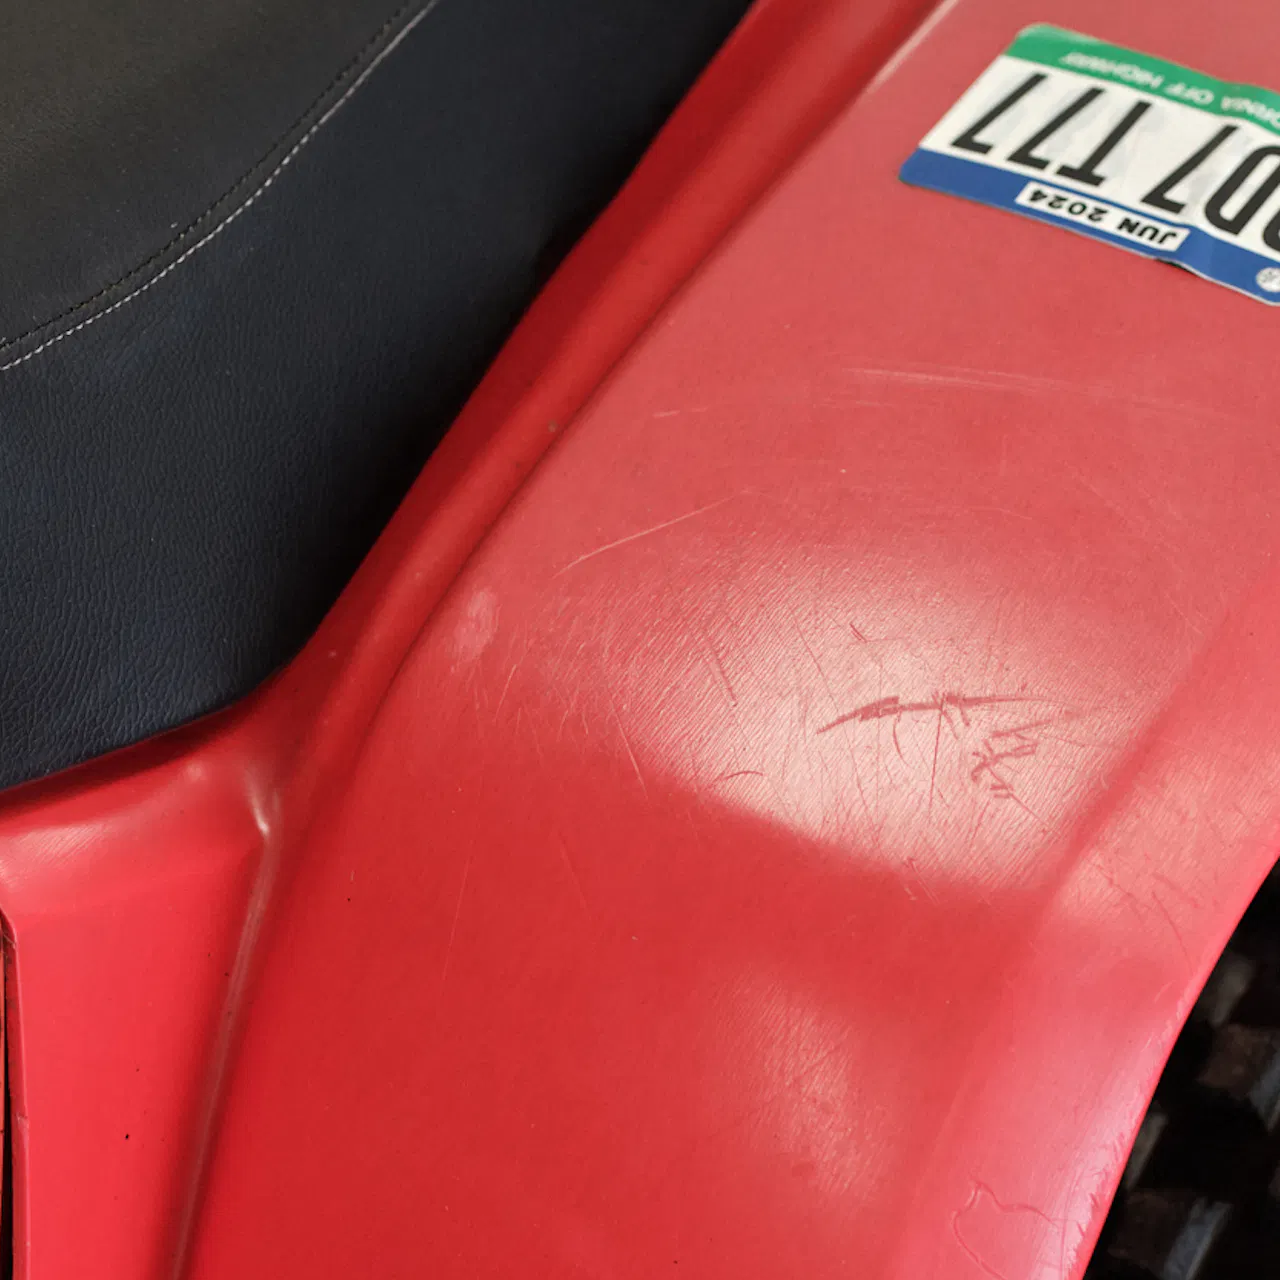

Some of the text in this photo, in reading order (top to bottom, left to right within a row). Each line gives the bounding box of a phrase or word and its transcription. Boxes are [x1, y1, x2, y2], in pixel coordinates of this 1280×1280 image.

[1165, 82, 1214, 105] OFF
[950, 73, 1153, 186] T77
[1028, 189, 1178, 245] JUN 2024
